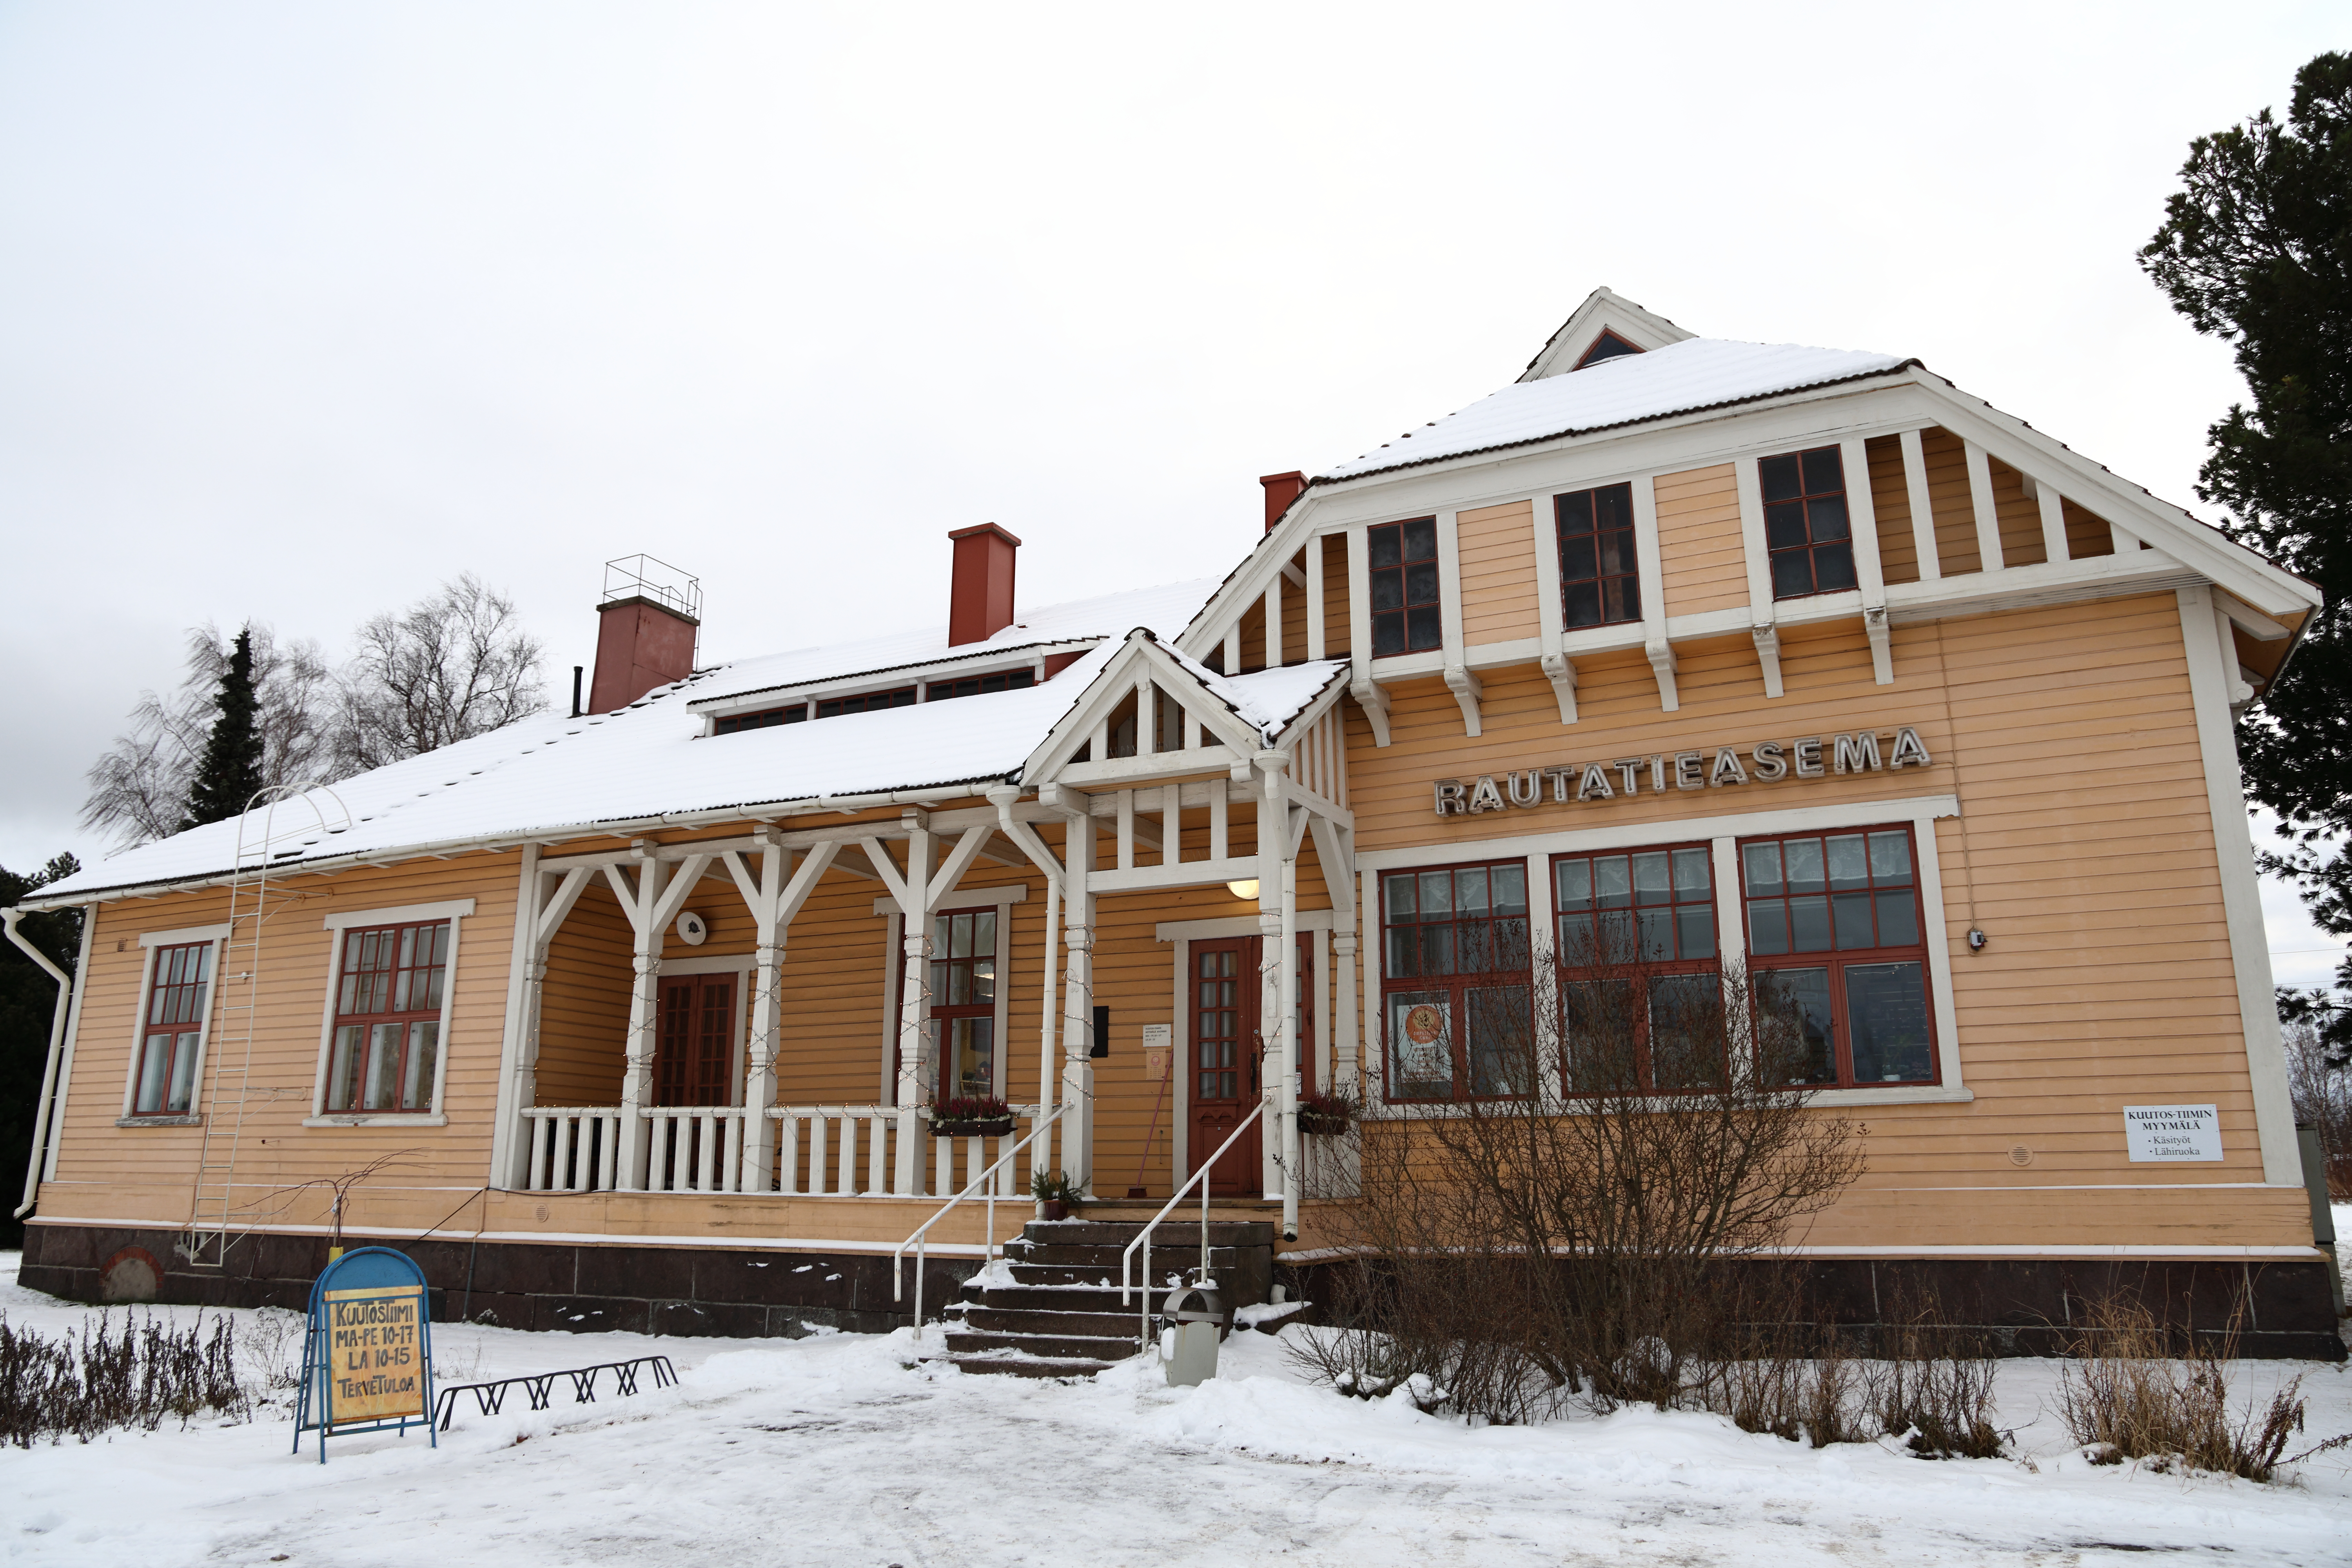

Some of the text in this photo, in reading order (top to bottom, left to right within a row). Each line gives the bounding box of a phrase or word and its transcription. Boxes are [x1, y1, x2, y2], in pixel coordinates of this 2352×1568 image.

[1434, 726, 1933, 818] RAUTATIEASEMA
[2128, 1110, 2212, 1120] KUUTOS-TIIMIN
[2142, 1120, 2201, 1130] MYYMÄLÄ
[2153, 1136, 2191, 1145] Käsityöt
[2154, 1147, 2200, 1155] Lähiruoka
[336, 1325, 414, 1348] MA-PE 10-17
[348, 1347, 410, 1370] LA 10-15
[337, 1375, 415, 1399] TERVETULOA
